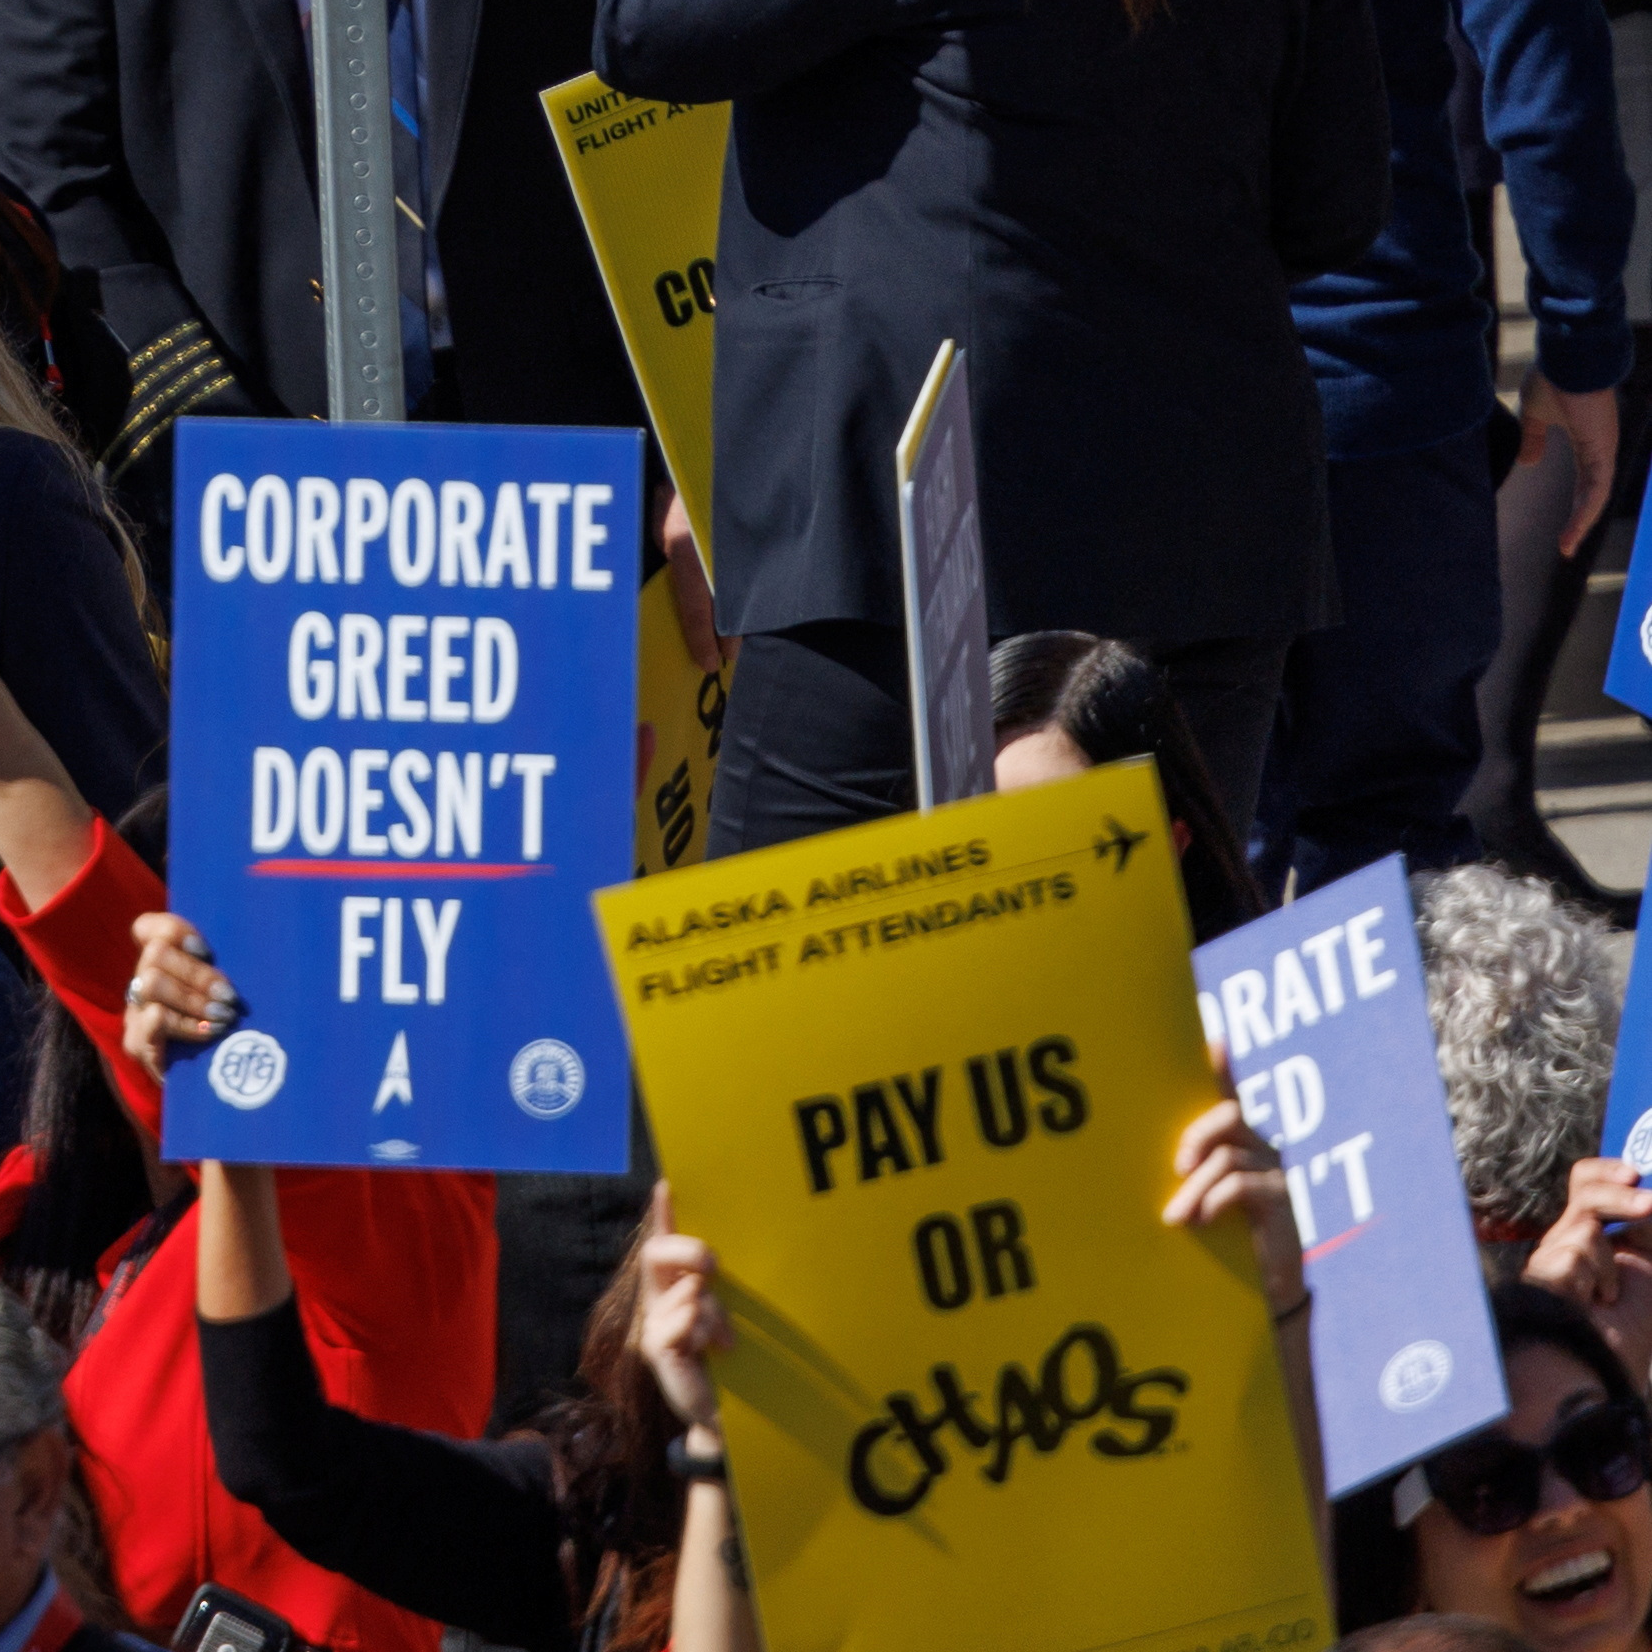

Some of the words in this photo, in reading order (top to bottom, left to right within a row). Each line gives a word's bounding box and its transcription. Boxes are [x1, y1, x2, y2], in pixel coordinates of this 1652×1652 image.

[576, 108, 656, 154] FLIGHT
[201, 473, 612, 590] CORPORATE
[289, 611, 518, 723] GREED
[252, 747, 555, 860] DOESN'T
[340, 897, 461, 1004] FLY
[628, 891, 791, 951] ALASKA
[805, 840, 991, 910] AIRLINES
[639, 945, 785, 1005] FLIGHT
[799, 872, 1076, 964] ATTENDANTS
[795, 1067, 944, 1194] PAY
[967, 1036, 1088, 1149] US
[913, 1200, 1034, 1312] OR
[848, 1323, 1188, 1519] CHAOS
